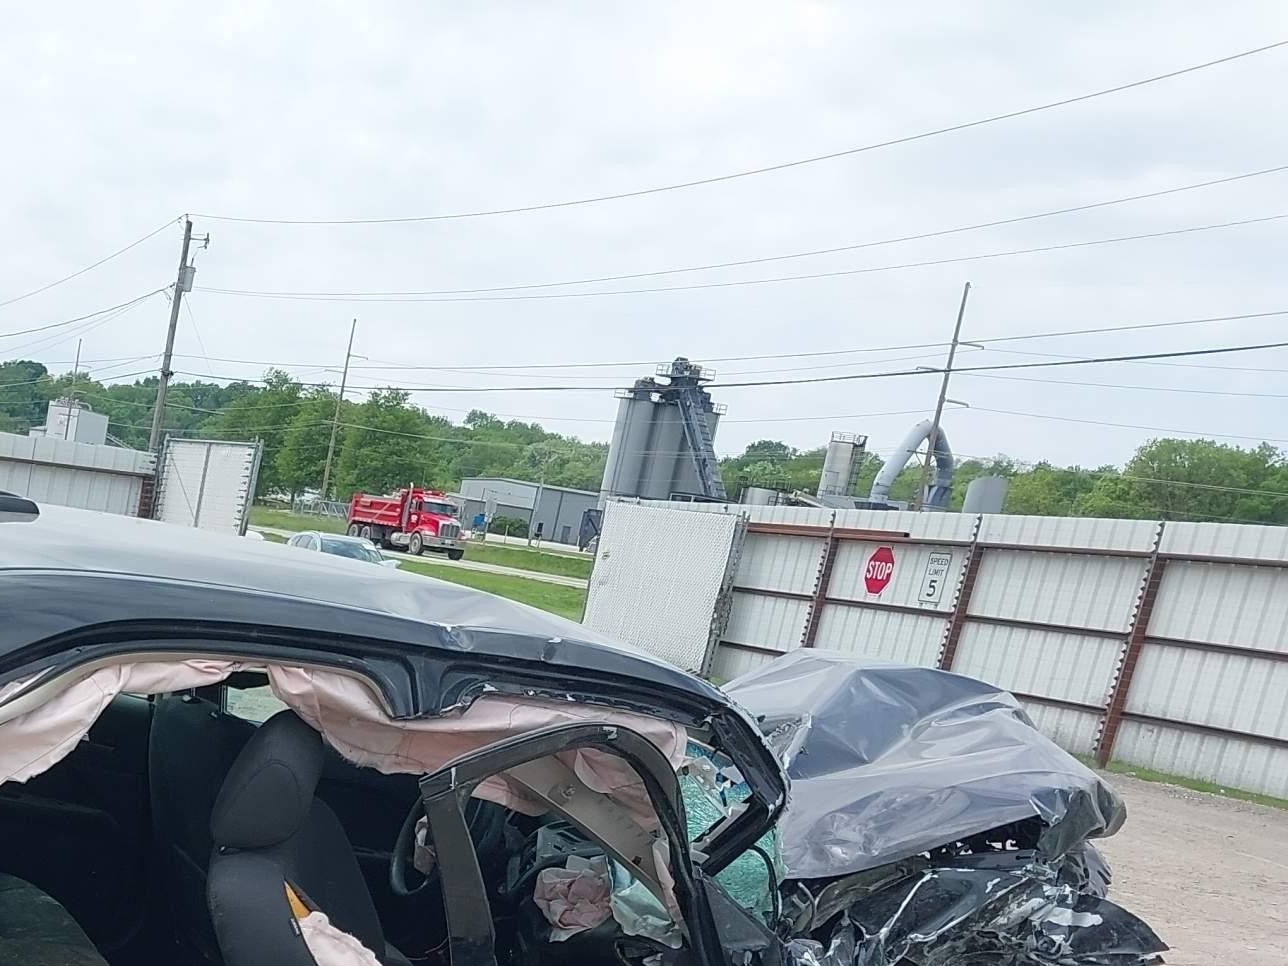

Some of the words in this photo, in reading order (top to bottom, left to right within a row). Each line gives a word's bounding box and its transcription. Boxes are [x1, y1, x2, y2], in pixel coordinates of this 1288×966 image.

[929, 557, 949, 566] SPEED
[866, 561, 893, 580] STOP
[926, 580, 938, 597] 5
